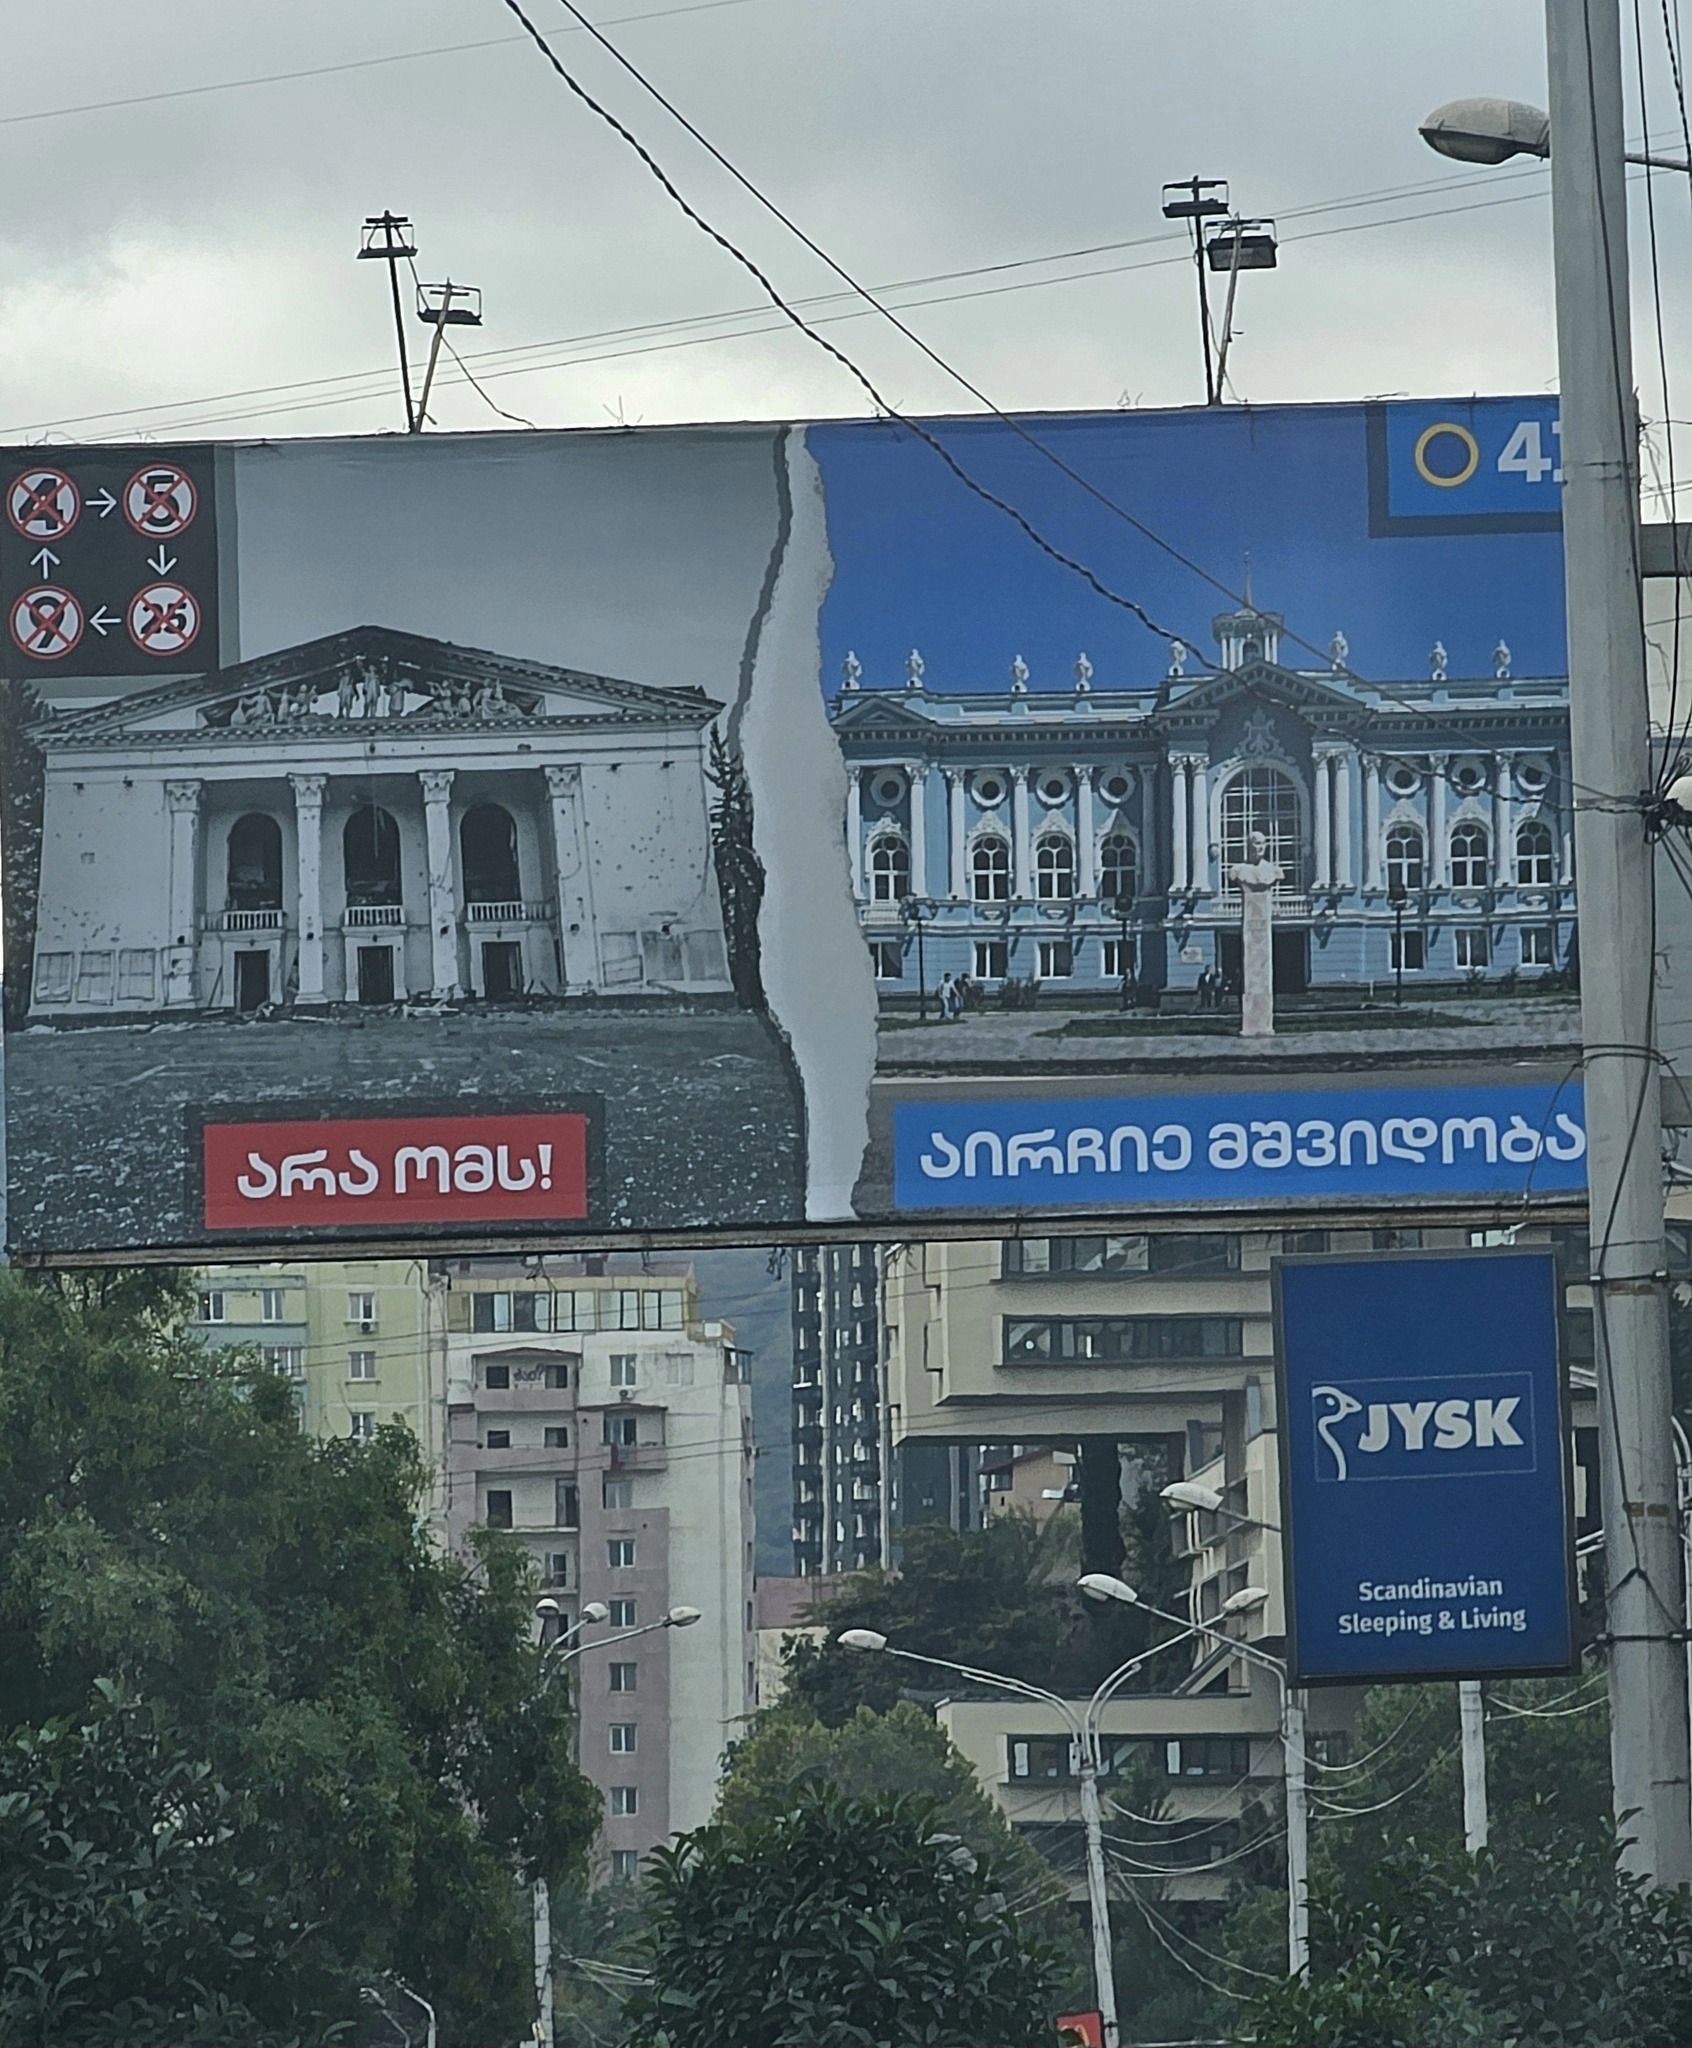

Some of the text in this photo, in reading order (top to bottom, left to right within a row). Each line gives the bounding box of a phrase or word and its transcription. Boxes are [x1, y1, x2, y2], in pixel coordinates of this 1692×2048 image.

[19, 478, 63, 530] 4
[144, 475, 180, 527] 5
[29, 596, 65, 648] 9
[237, 1144, 552, 1199] არა ომს!
[920, 1113, 1586, 1179] აირჩიე მშვიდობა
[1358, 1397, 1524, 1453] JYSK
[1358, 1575, 1503, 1601] Scandinavian
[1338, 1606, 1527, 1637] Sleeping & Living
